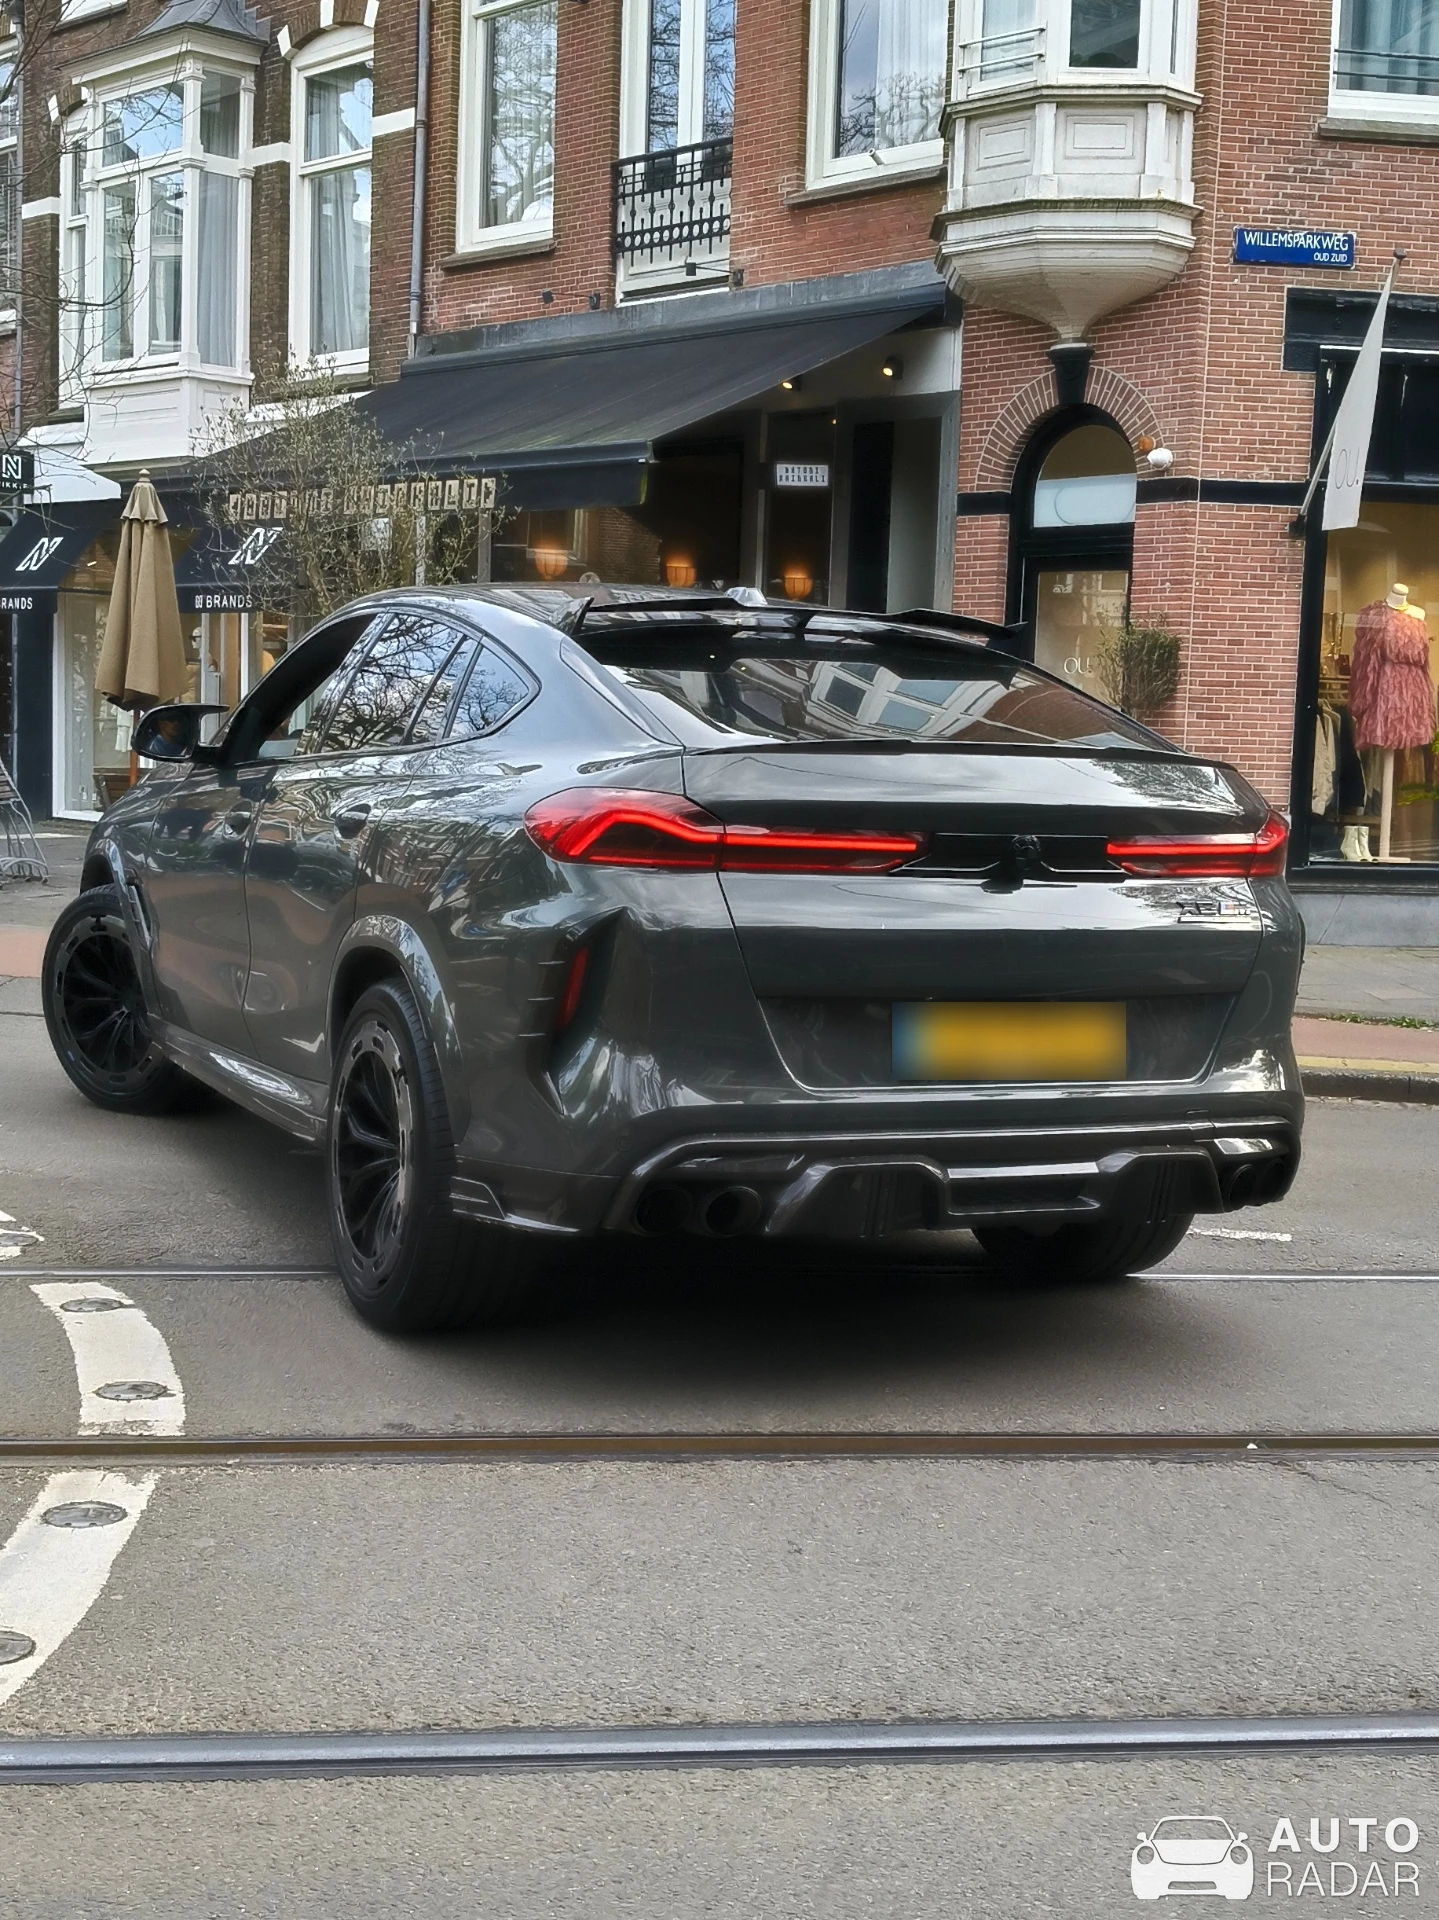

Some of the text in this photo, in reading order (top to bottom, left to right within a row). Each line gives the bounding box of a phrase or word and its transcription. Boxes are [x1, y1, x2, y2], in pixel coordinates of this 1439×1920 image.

[1244, 231, 1348, 251] WILLEMSPARKWEG
[1313, 252, 1347, 263] OUD ZUID
[0, 597, 33, 610] RANDS
[206, 594, 253, 608] BRANDS
